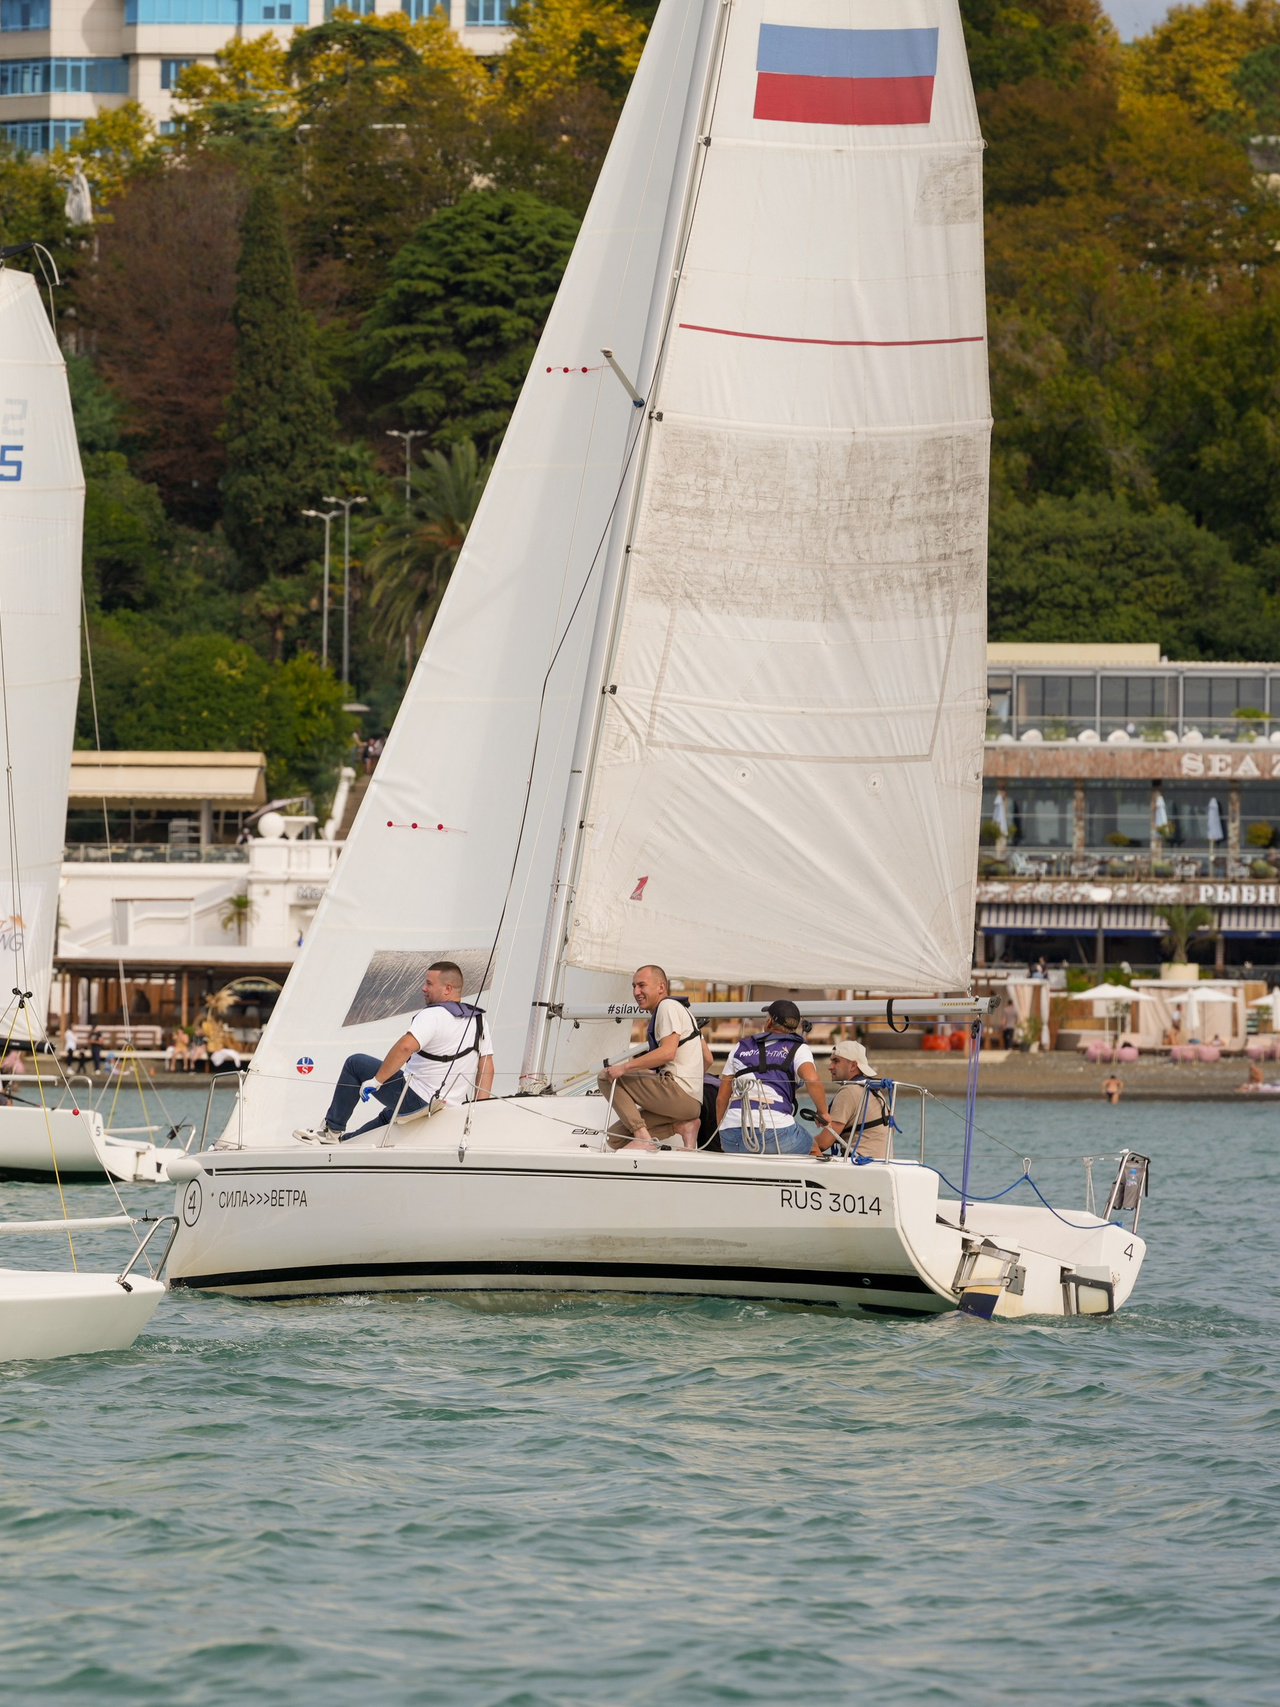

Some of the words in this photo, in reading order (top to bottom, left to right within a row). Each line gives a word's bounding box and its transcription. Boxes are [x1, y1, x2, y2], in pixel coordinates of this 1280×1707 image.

[1182, 753, 1261, 776] SEA
[1199, 884, 1280, 904] РЫБН
[95, 1125, 101, 1137] 5
[780, 1189, 822, 1211] RUS
[828, 1192, 882, 1216] 3014
[1123, 1243, 1134, 1262] 4
